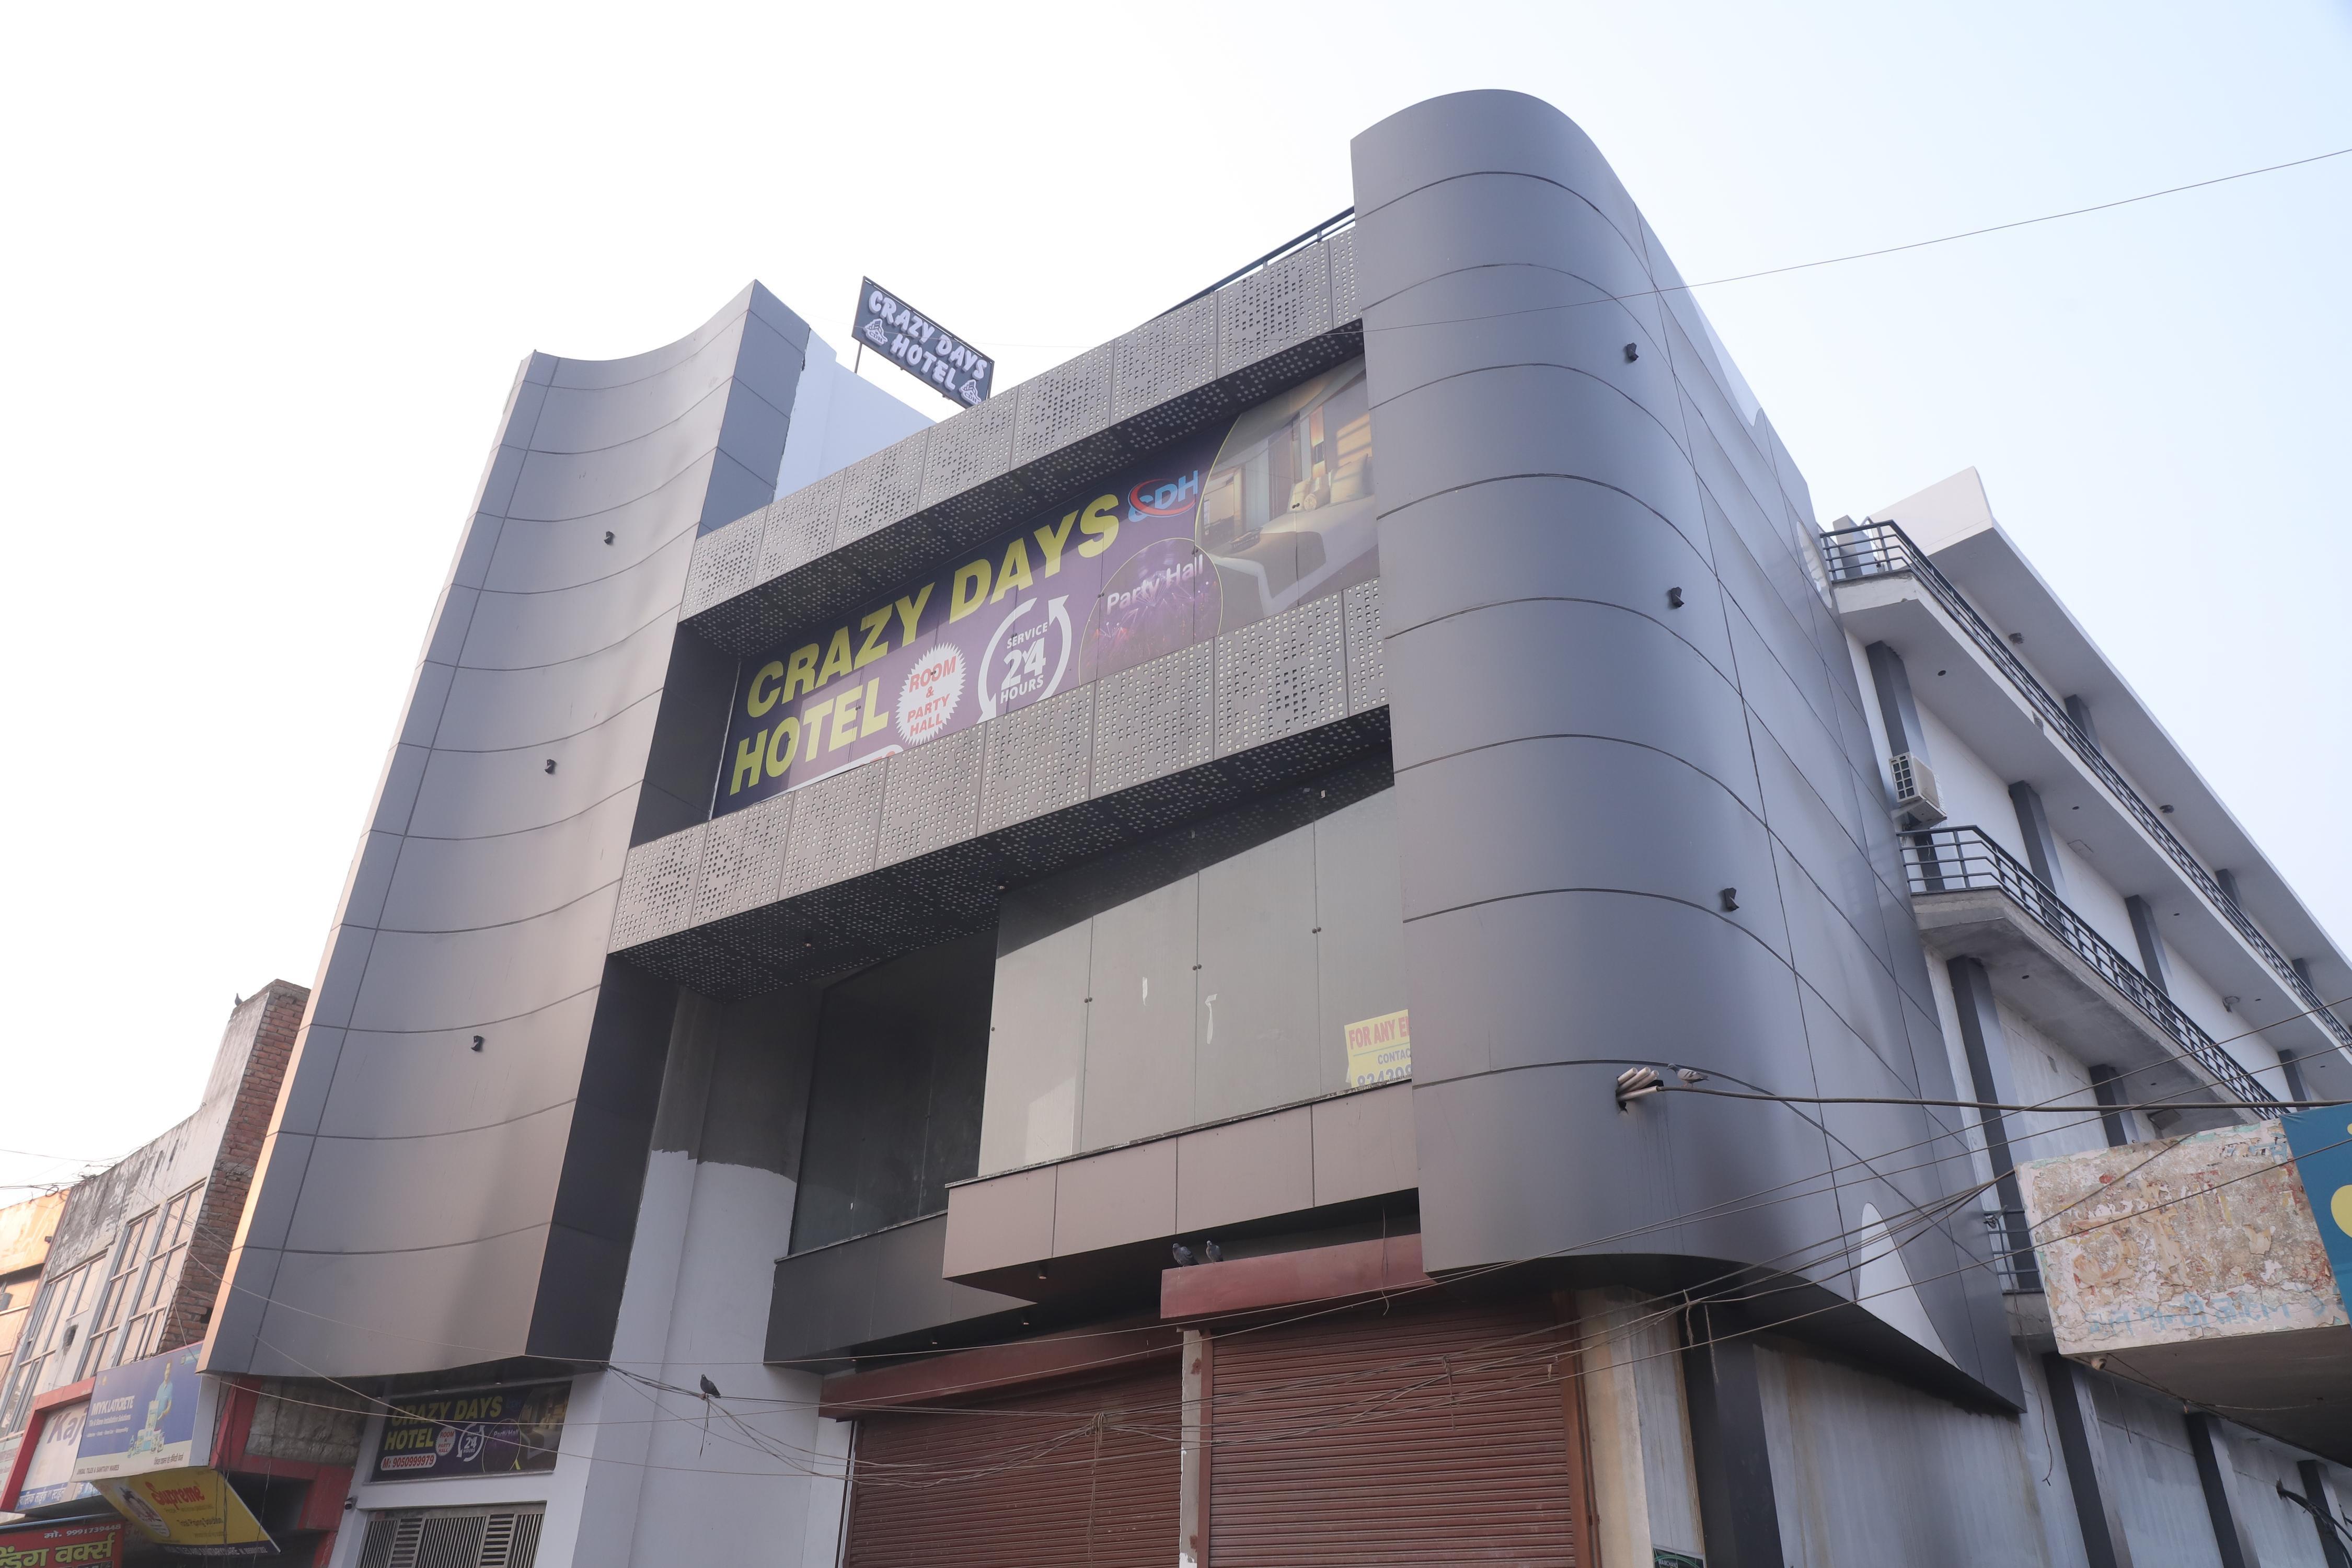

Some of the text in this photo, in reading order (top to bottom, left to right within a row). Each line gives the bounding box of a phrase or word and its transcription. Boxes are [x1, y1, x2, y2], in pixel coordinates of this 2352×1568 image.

[868, 291, 987, 381] CRAZY DAYS
[869, 331, 883, 343] CDH
[890, 333, 956, 391] HOTEL
[964, 392, 977, 403] CDH
[1128, 470, 1198, 522] CDH
[1106, 554, 1203, 615] Party Hall
[747, 494, 1119, 718] CRAZY DAYS
[1007, 621, 1048, 649] SERVICE
[909, 655, 956, 693] ROOM
[1001, 637, 1046, 690] 24
[926, 686, 935, 698] &
[1000, 675, 1044, 705] HOURS
[907, 693, 950, 723] PARTY
[730, 677, 889, 795] HOTEL
[910, 713, 943, 737] HALL
[1348, 1026, 1372, 1050] FOR
[1374, 1019, 1395, 1044] ANY
[392, 1396, 503, 1426] CRAZY DAYS
[385, 1427, 434, 1450] HOTEL
[464, 1436, 478, 1449] 24
